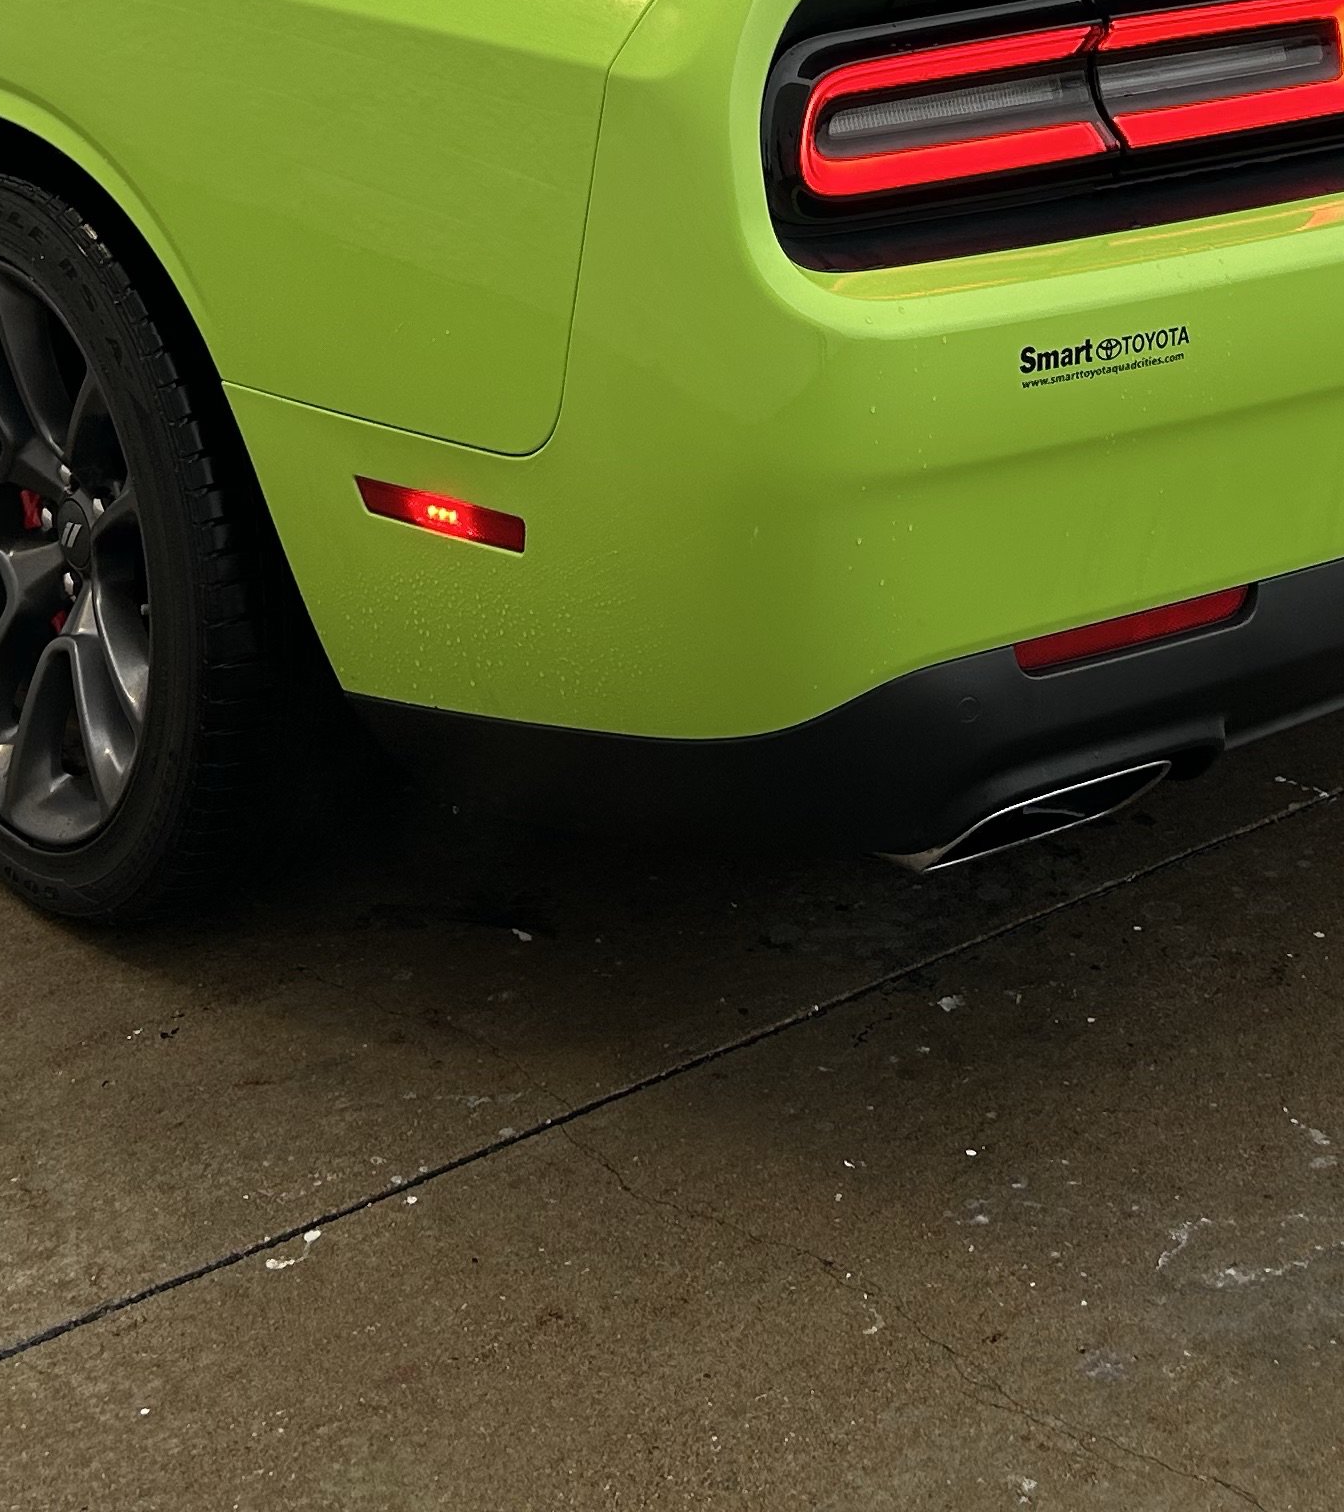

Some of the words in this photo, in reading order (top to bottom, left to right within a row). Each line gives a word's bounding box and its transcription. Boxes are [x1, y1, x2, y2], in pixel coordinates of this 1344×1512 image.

[1020, 338, 1093, 374] Smart
[1122, 326, 1190, 355] TOYOTA
[1021, 352, 1185, 389] www.smarttoyotaquadcities.com
